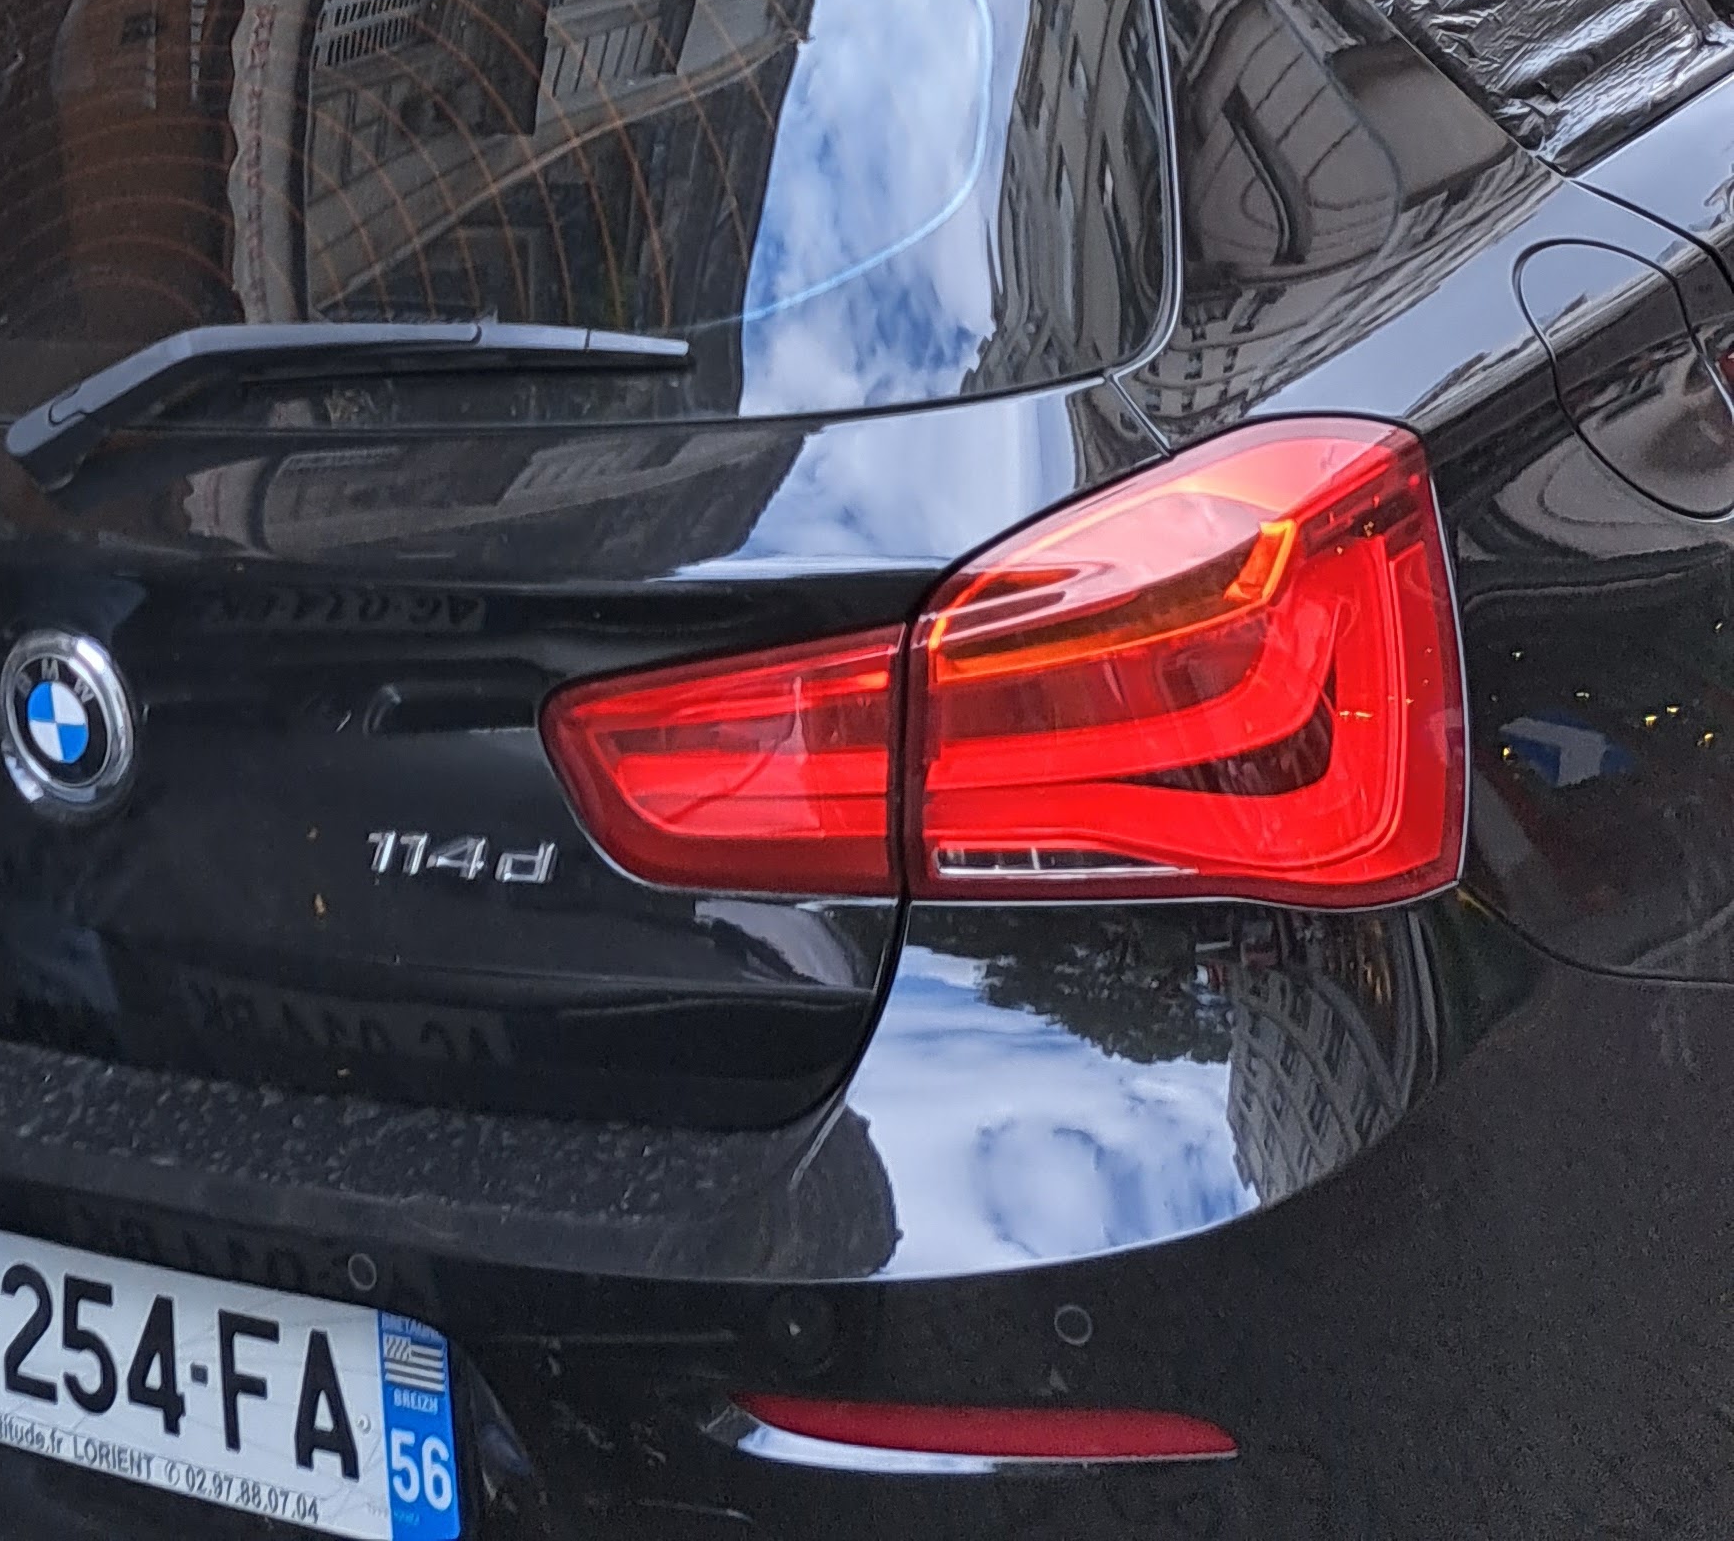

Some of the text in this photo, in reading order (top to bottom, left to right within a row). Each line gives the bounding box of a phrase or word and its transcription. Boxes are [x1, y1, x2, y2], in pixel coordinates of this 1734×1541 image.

[368, 830, 556, 884] 114d
[74, 1434, 155, 1480] LORIENT
[390, 1427, 453, 1512] 56
